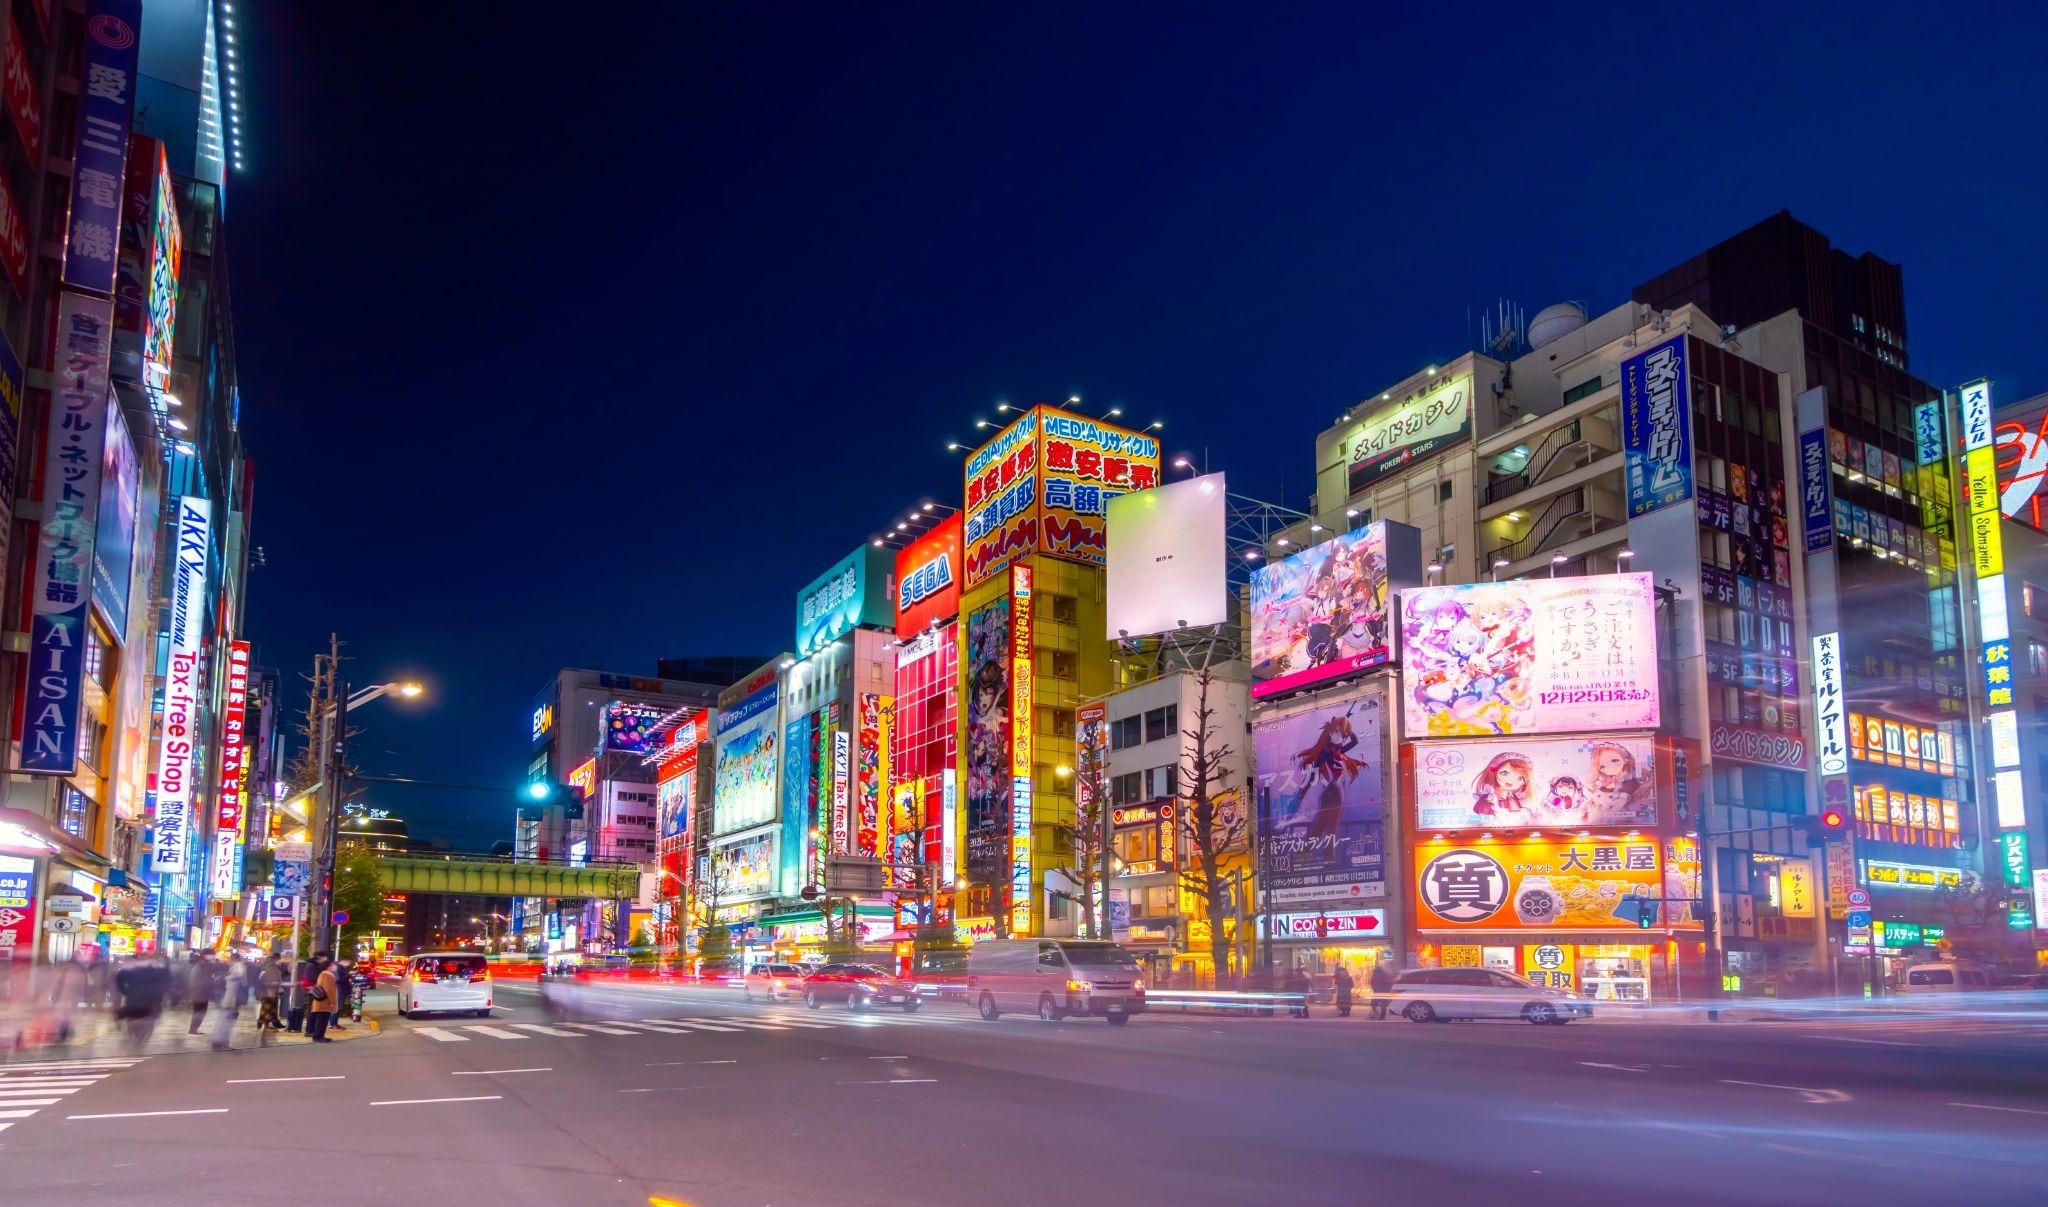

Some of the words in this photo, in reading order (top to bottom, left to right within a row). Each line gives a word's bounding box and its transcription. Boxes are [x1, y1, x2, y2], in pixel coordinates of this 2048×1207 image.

[72, 62, 127, 263] 愛三電機
[1354, 391, 1462, 461] メイドカジノ
[967, 438, 1037, 512] 激安販売
[1045, 440, 1156, 490] 激安販売
[1380, 457, 1401, 472] POKER
[1411, 441, 1434, 457] STARS
[966, 475, 1036, 548] 高額買取
[1973, 476, 1986, 509] Yellow
[181, 503, 208, 577] AKKY
[1056, 546, 1091, 561] ムーラン
[1976, 518, 1991, 571] Submarine
[172, 555, 191, 648] INTERNATIONAL
[901, 553, 952, 611] SEGA
[1583, 599, 1600, 651] うさぎ
[1605, 600, 1624, 666] ご注文は
[34, 622, 73, 755] AISAN
[1986, 644, 2013, 706] 秋葉館
[226, 720, 242, 772] カラオケ
[1712, 727, 1803, 766] メイドカジノ
[1513, 863, 1553, 873] チケット
[1559, 846, 1657, 873] 大黒屋
[1432, 860, 1499, 913] 質
[1293, 919, 1335, 932] COMC
[1338, 917, 1357, 930] ZIN
[1528, 971, 1573, 988] 買取
[1537, 948, 1561, 967] 質
